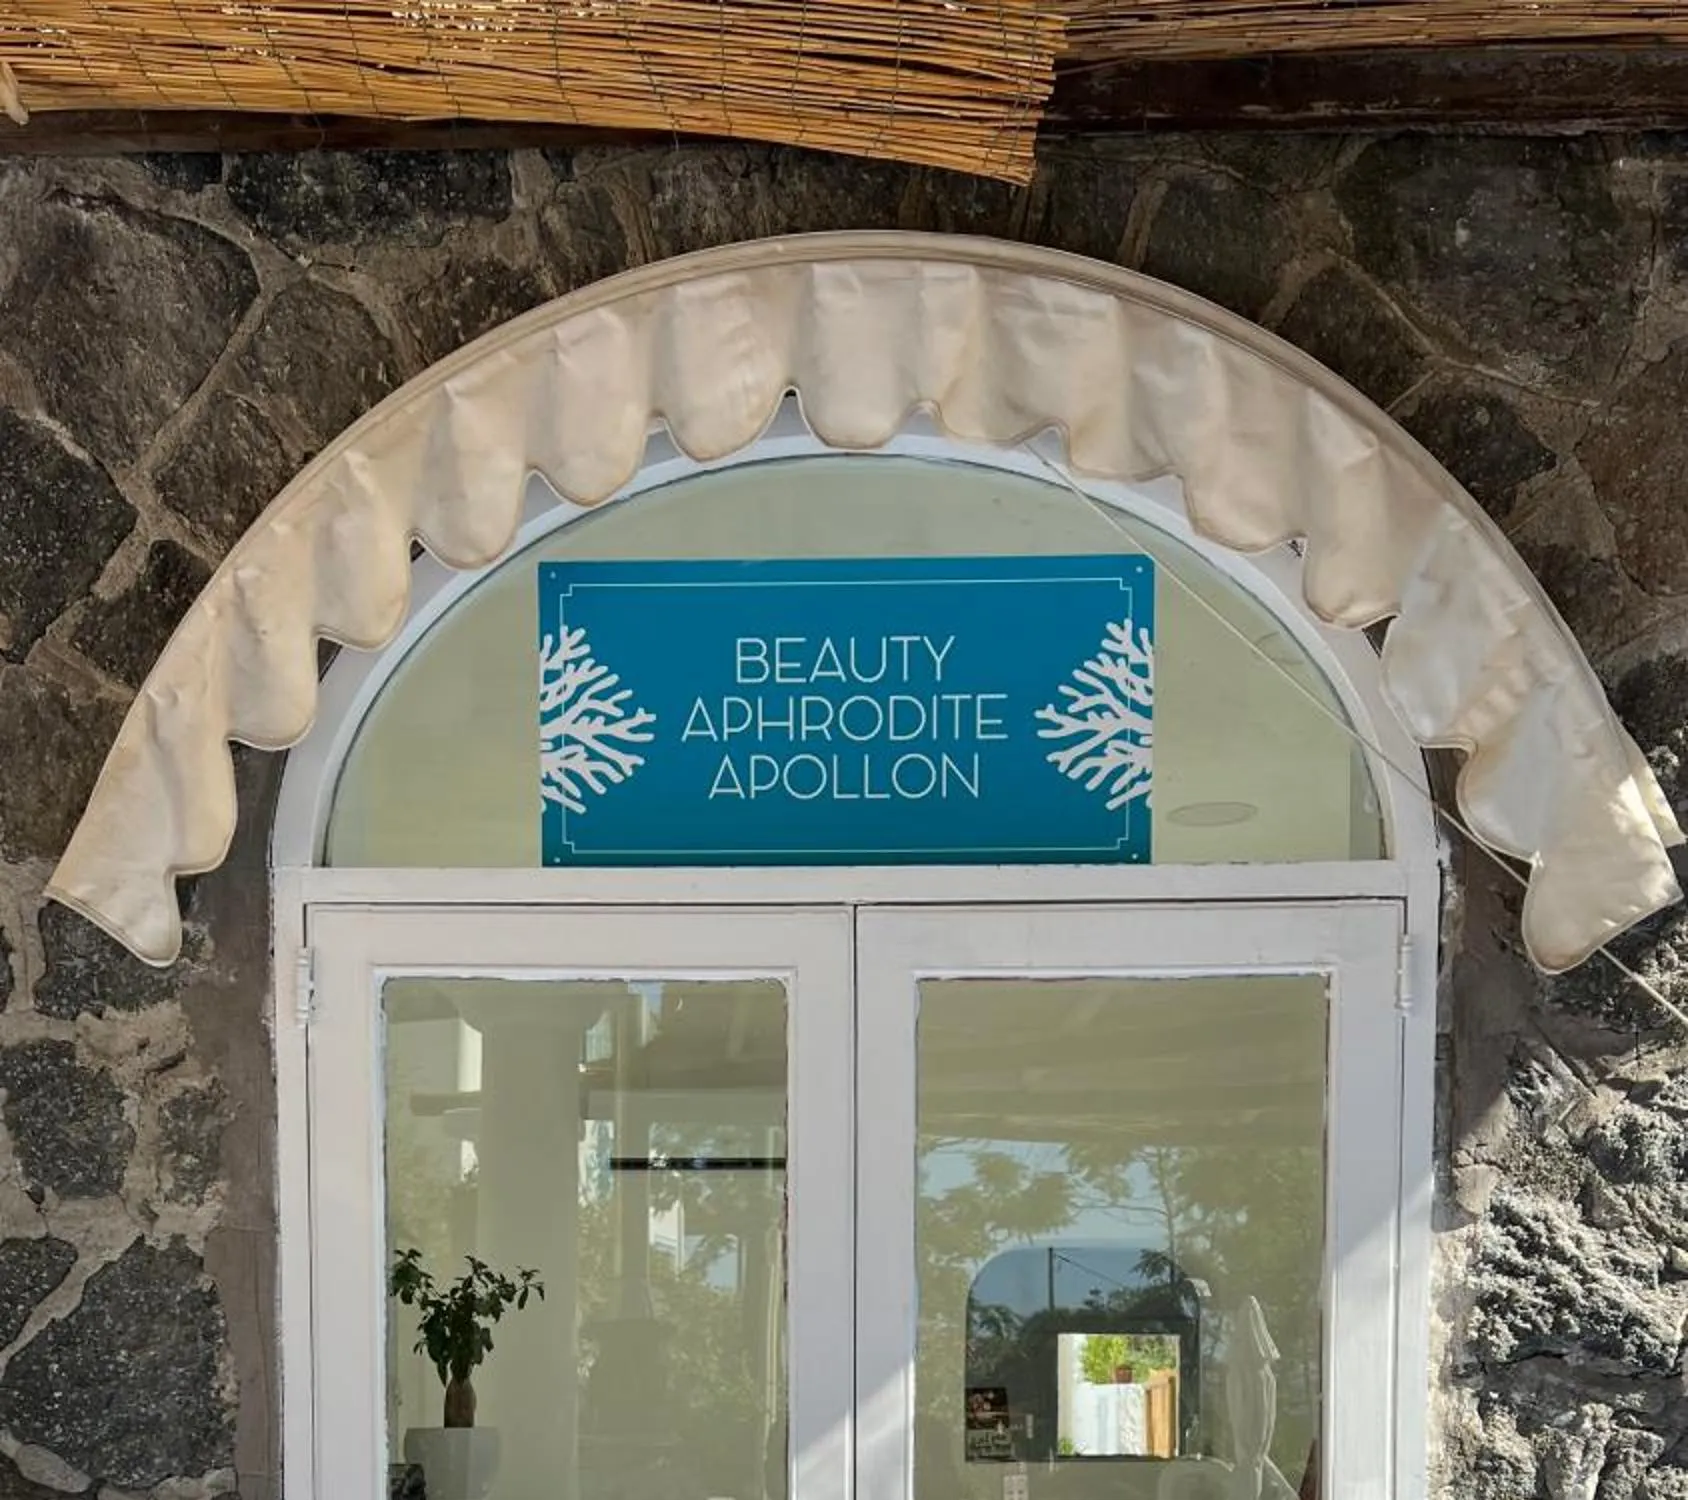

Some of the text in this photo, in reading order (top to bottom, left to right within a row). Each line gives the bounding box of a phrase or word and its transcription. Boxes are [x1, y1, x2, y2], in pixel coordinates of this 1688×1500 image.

[736, 636, 955, 683] BEAUTY
[681, 694, 1008, 742] APHRODITE
[708, 753, 979, 799] APOLLON
